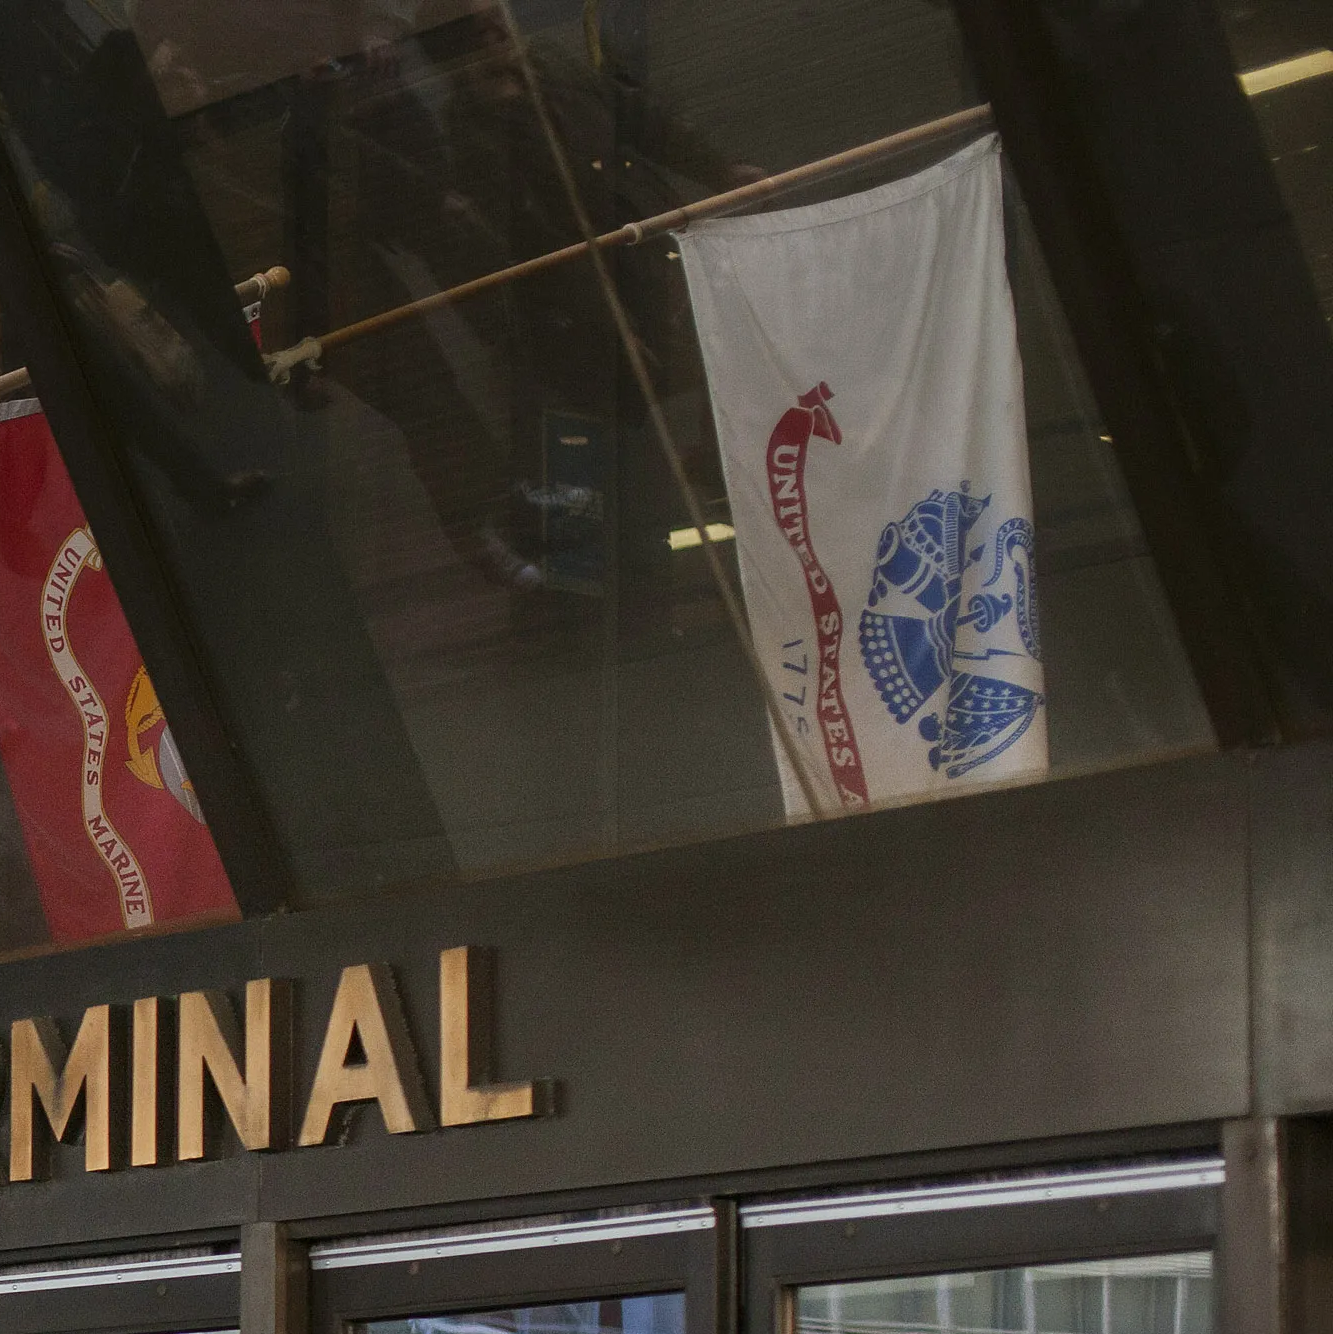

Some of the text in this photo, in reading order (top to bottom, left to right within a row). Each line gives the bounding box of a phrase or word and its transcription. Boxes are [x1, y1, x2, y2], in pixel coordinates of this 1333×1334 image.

[44, 546, 146, 916] UNITED STATES MARINE
[771, 442, 827, 596] UNITED
[819, 610, 856, 767] STATES
